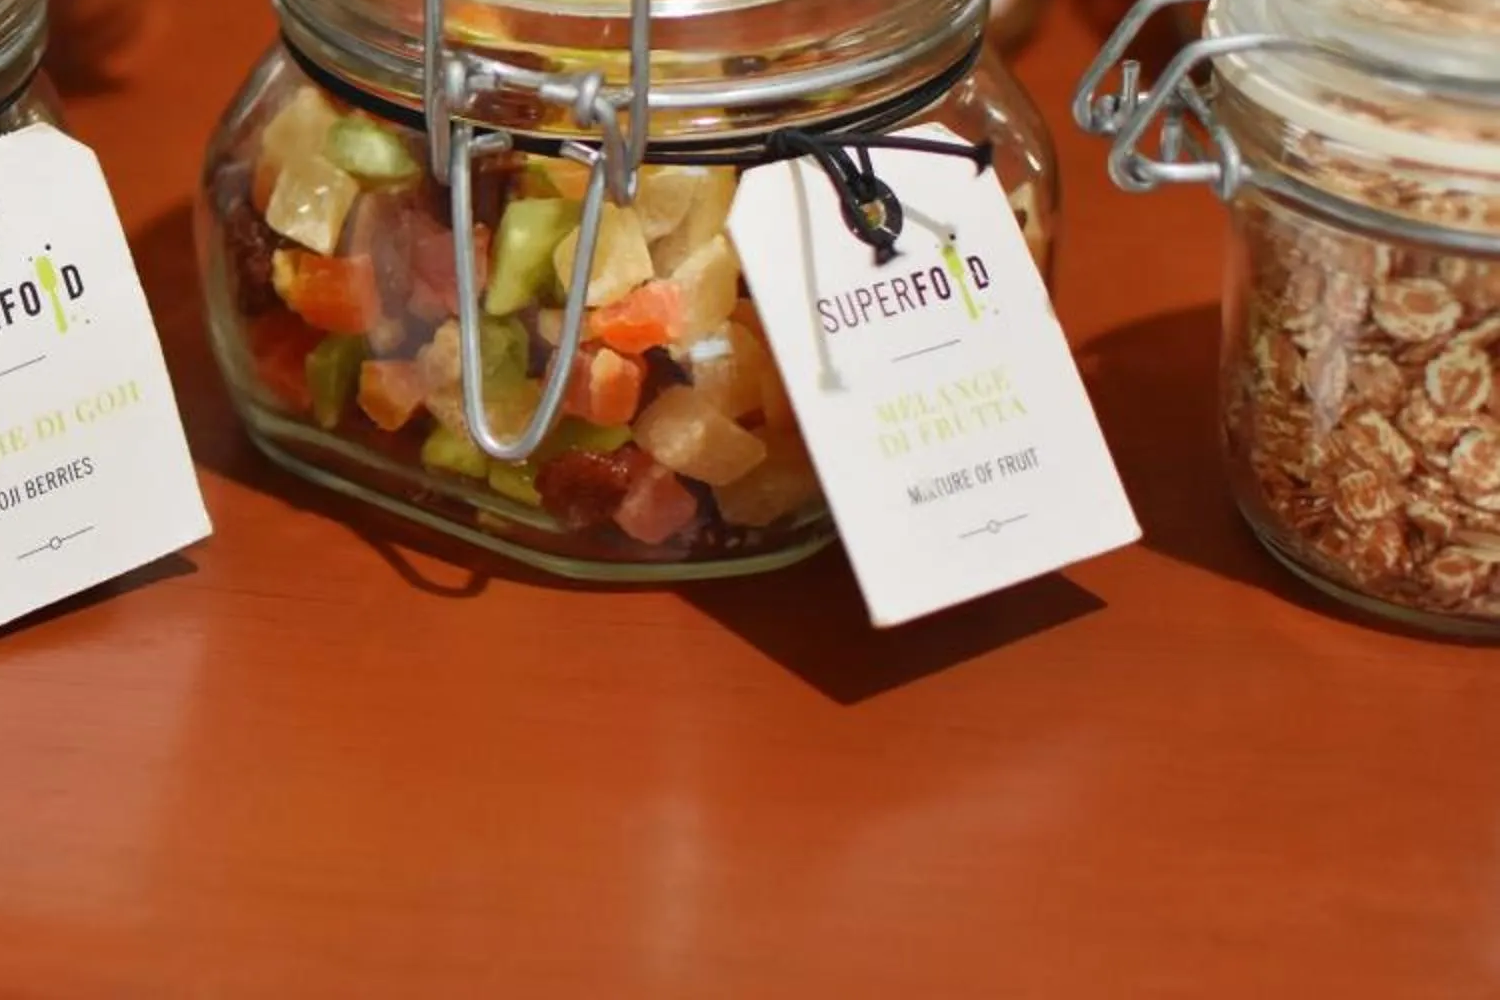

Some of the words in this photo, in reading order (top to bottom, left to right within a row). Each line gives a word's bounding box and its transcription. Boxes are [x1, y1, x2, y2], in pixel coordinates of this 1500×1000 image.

[34, 409, 66, 439] DI
[73, 379, 142, 424] GOJI
[877, 428, 911, 460] DI
[918, 396, 1028, 446] FRUTTA
[25, 455, 96, 500] BERRIES
[974, 460, 994, 485] OF
[997, 447, 1040, 477] FRUIT
